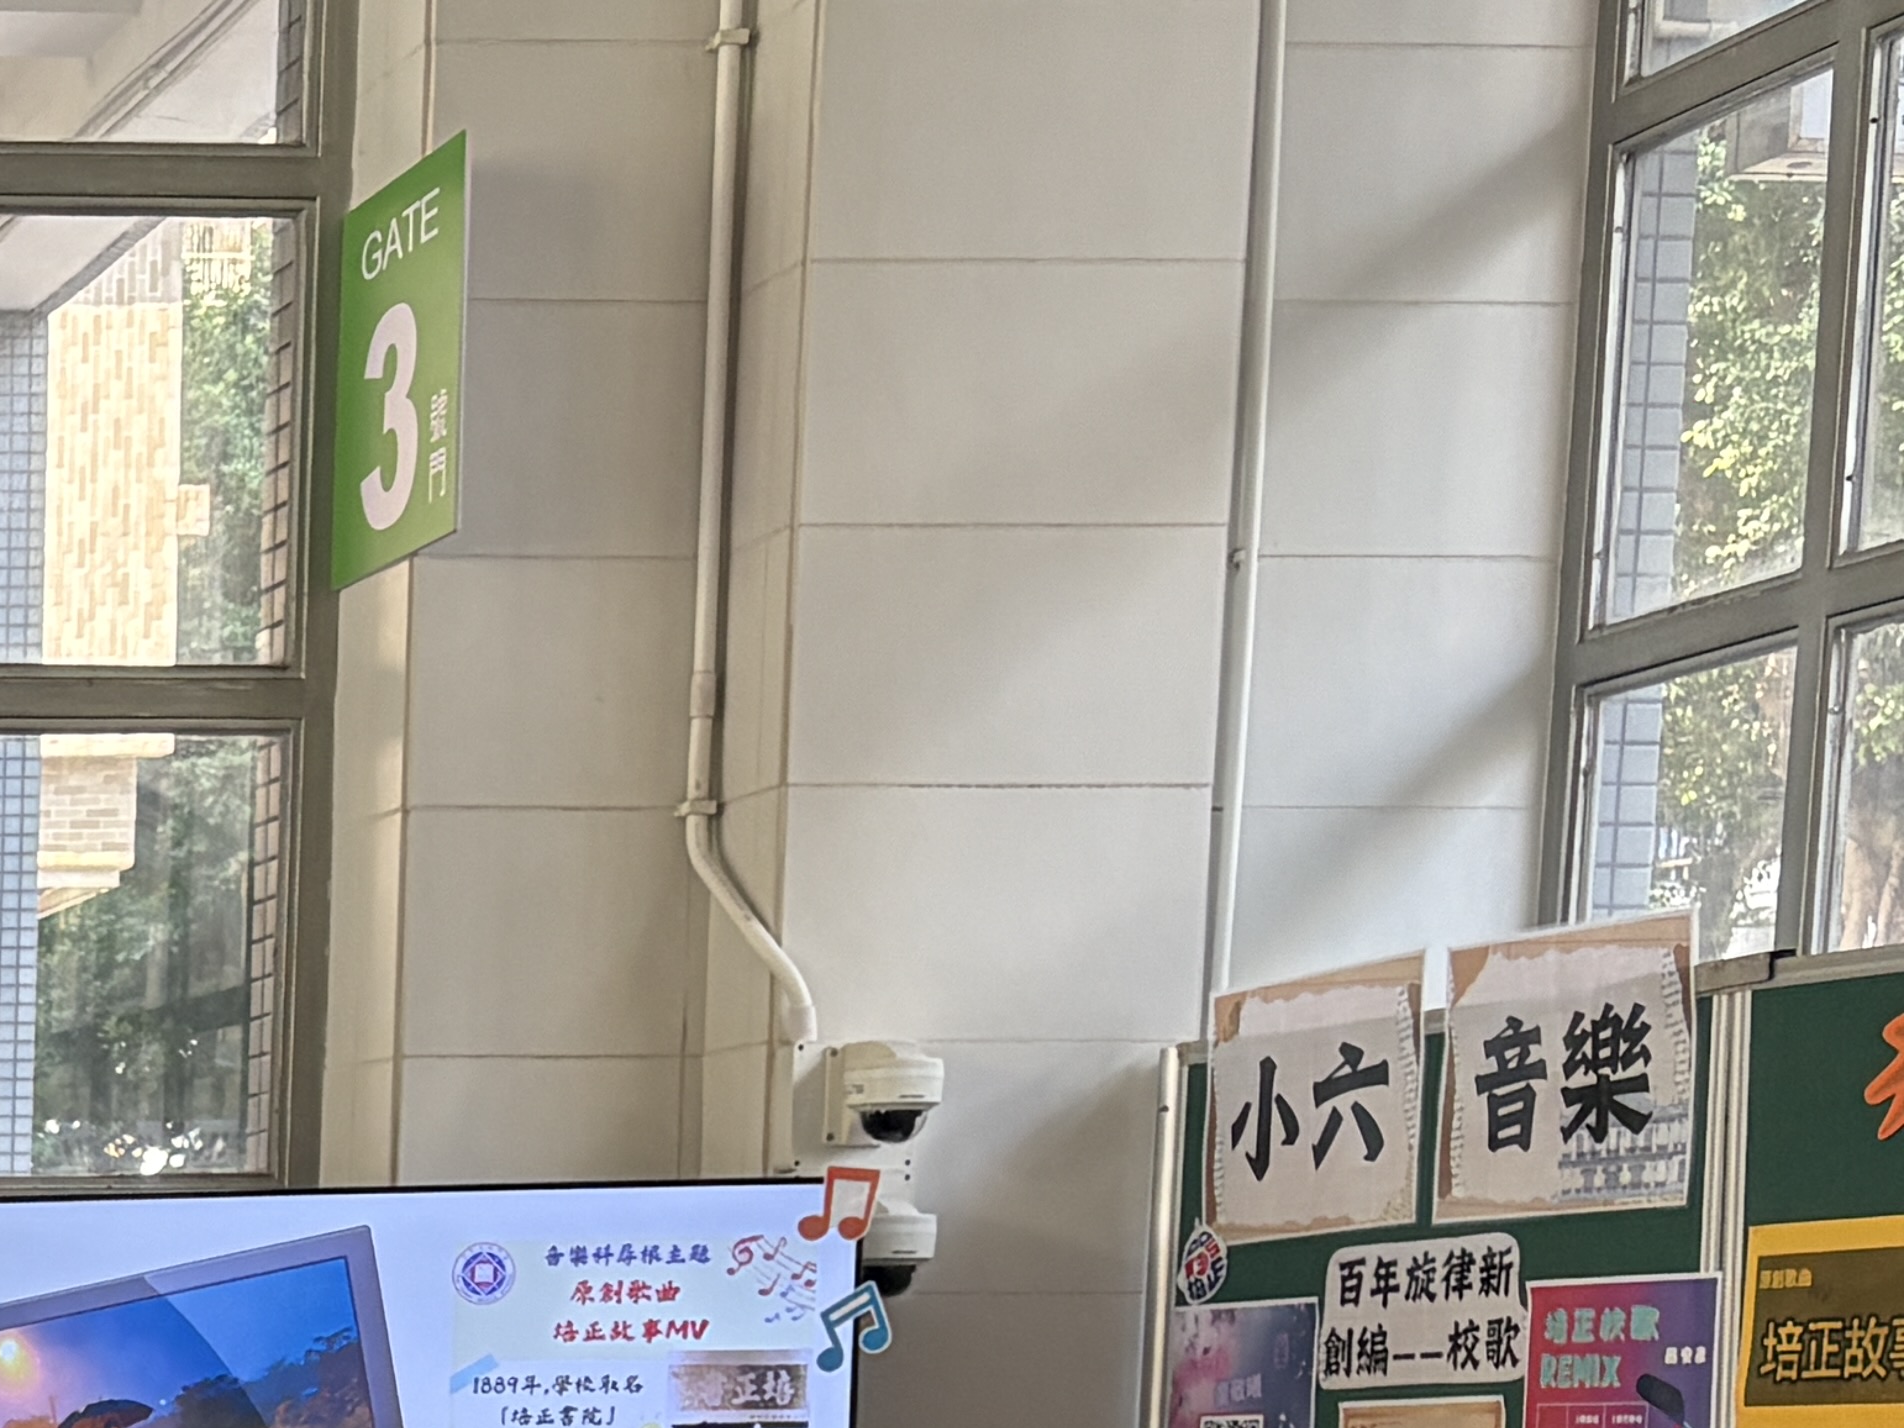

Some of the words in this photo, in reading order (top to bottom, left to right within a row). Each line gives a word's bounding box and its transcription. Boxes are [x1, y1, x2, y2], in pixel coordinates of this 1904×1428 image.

[361, 186, 440, 280] GATE
[360, 302, 419, 531] 3
[1231, 1042, 1390, 1182] 小六
[1474, 1001, 1654, 1156] 音樂
[569, 1279, 682, 1305] 原創歌曲
[1338, 1245, 1514, 1310] 百年旋律新
[552, 1318, 710, 1343] 培正故事MV
[1539, 1353, 1622, 1389] REMIX
